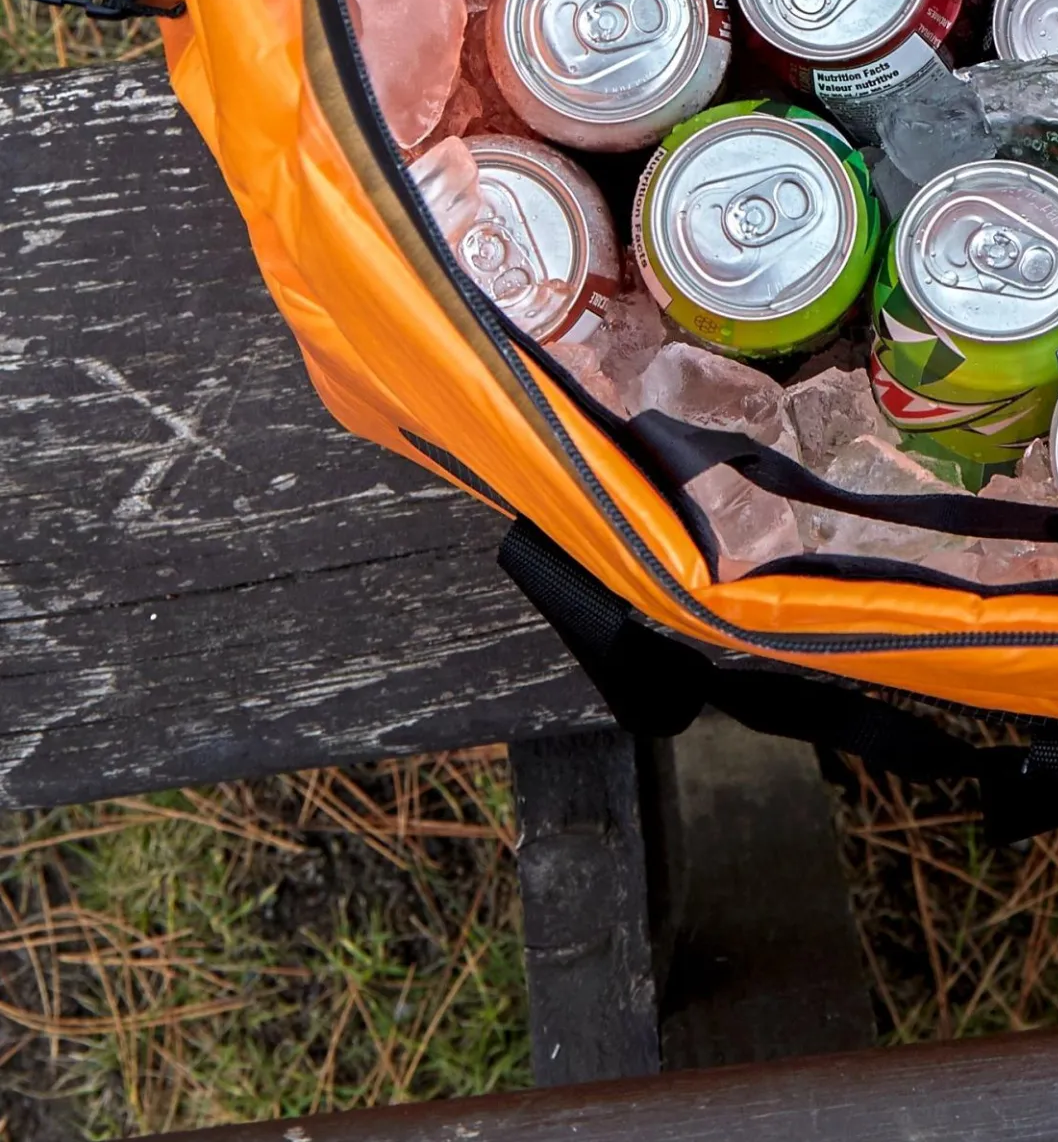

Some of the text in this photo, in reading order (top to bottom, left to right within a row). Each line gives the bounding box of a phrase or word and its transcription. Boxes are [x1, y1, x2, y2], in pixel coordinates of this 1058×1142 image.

[817, 71, 862, 83] Nutrition
[863, 62, 890, 77] Facts
[818, 82, 852, 93] Valeur
[855, 70, 900, 90] nutritive
[634, 149, 665, 268] Nutrition Facts
